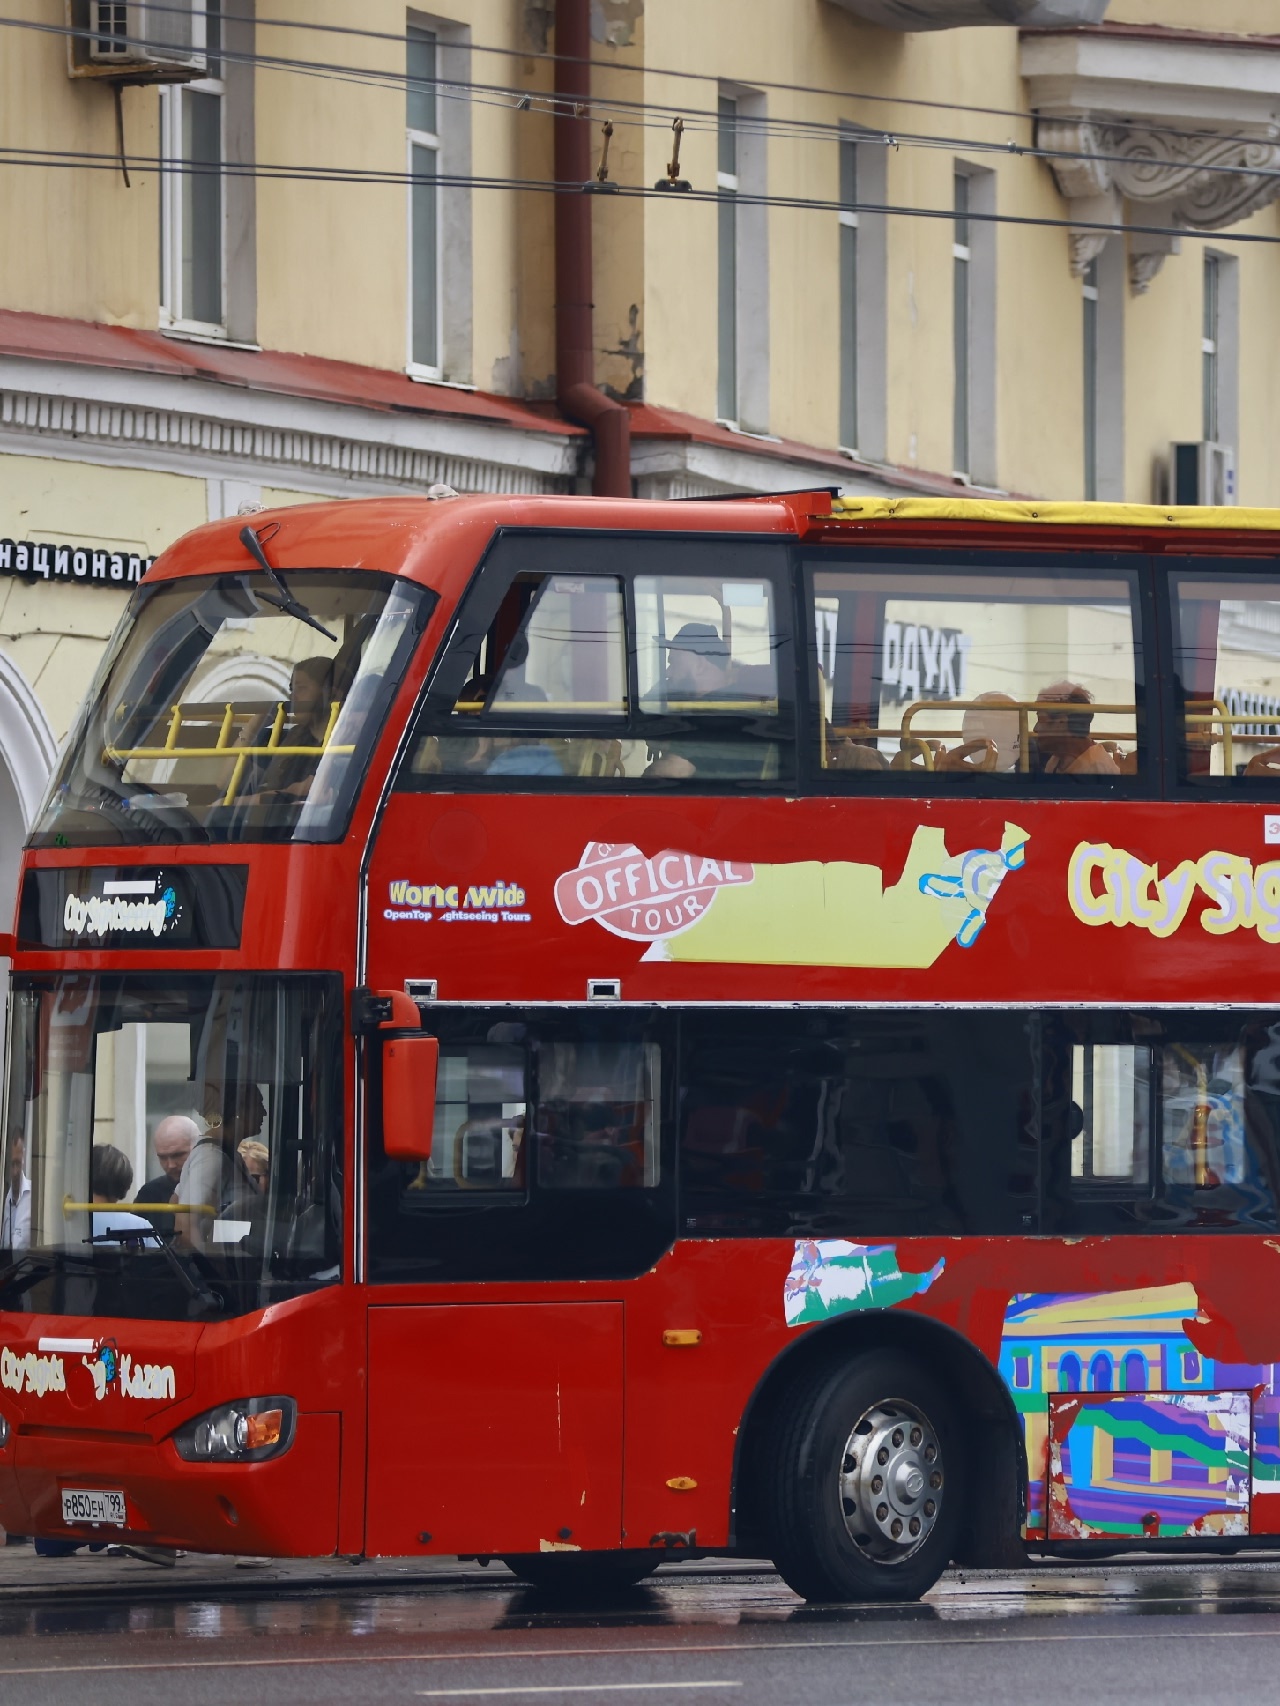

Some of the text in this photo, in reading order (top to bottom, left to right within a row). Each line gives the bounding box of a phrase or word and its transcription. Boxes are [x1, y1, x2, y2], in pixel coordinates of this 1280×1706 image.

[0, 543, 153, 583] национал
[576, 854, 743, 910] OFFICIAL
[500, 911, 532, 922] Tours
[630, 895, 704, 931] TOUR
[120, 1353, 176, 1399] Kazan
